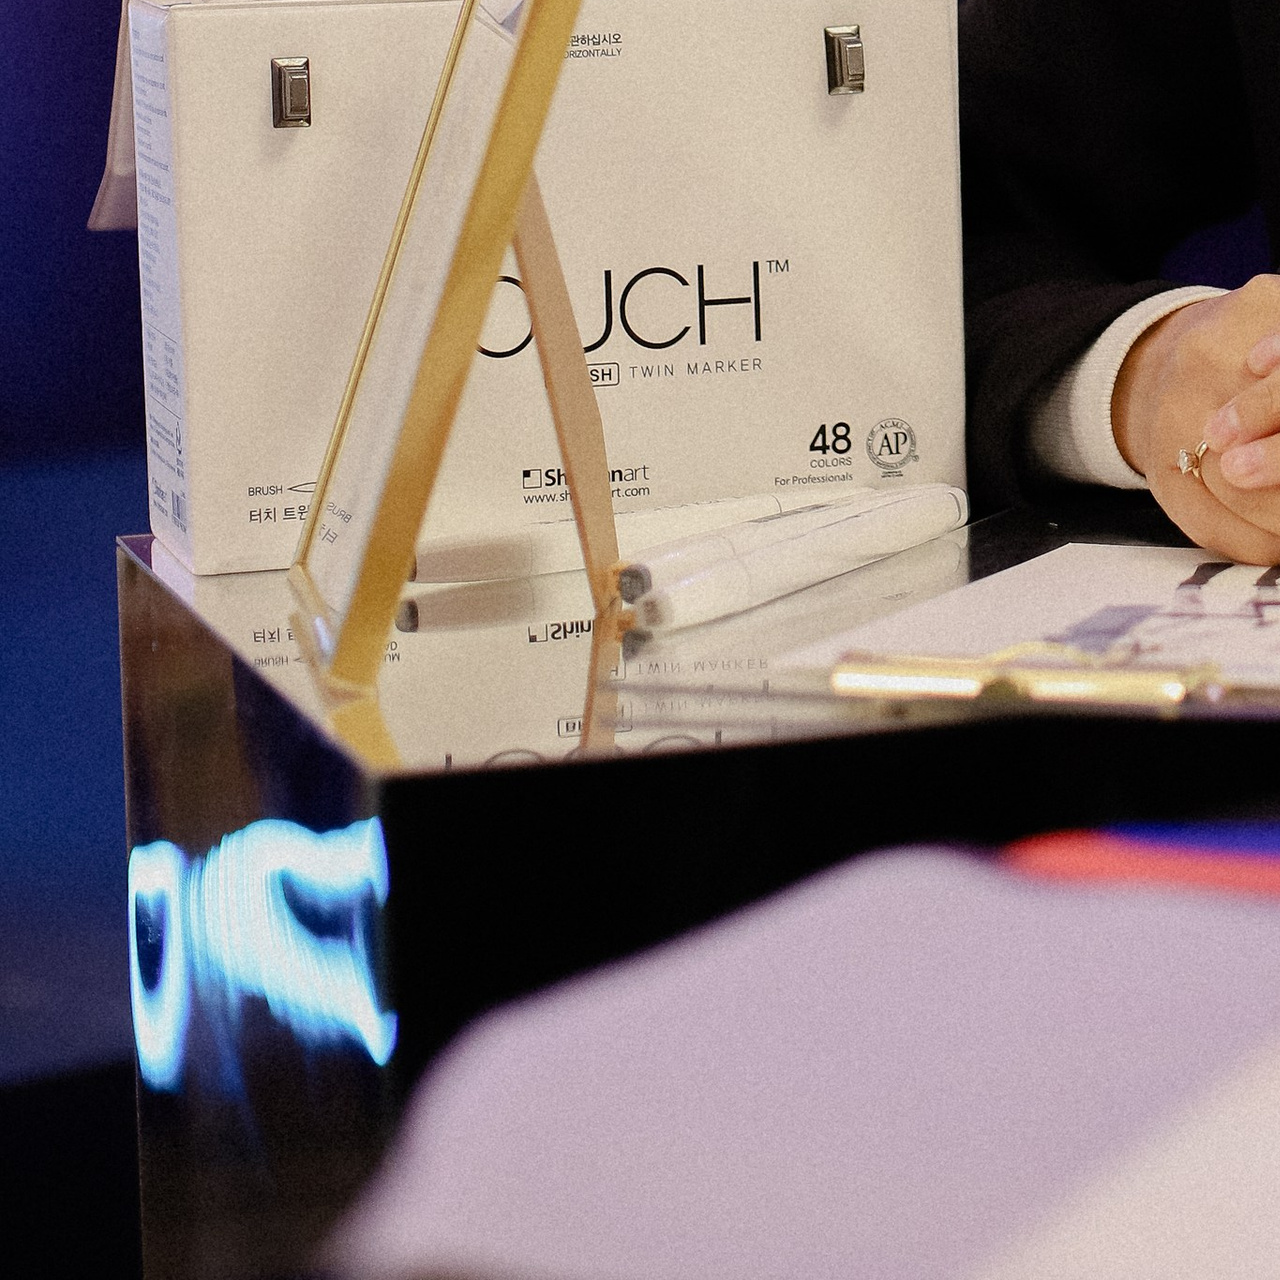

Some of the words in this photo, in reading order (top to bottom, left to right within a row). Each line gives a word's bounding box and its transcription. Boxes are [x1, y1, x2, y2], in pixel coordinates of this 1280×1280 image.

[566, 33, 622, 47] 관하십시오
[563, 48, 622, 59] ORIZONTALLY
[629, 364, 675, 379] TWIN
[687, 358, 763, 375] MARKER
[809, 422, 852, 455] 48
[877, 431, 908, 456] AP
[810, 457, 853, 469] COLORS
[774, 476, 790, 486] For
[792, 472, 853, 486] Professionals
[248, 485, 283, 497] BRUSH
[248, 507, 277, 524] 터치
